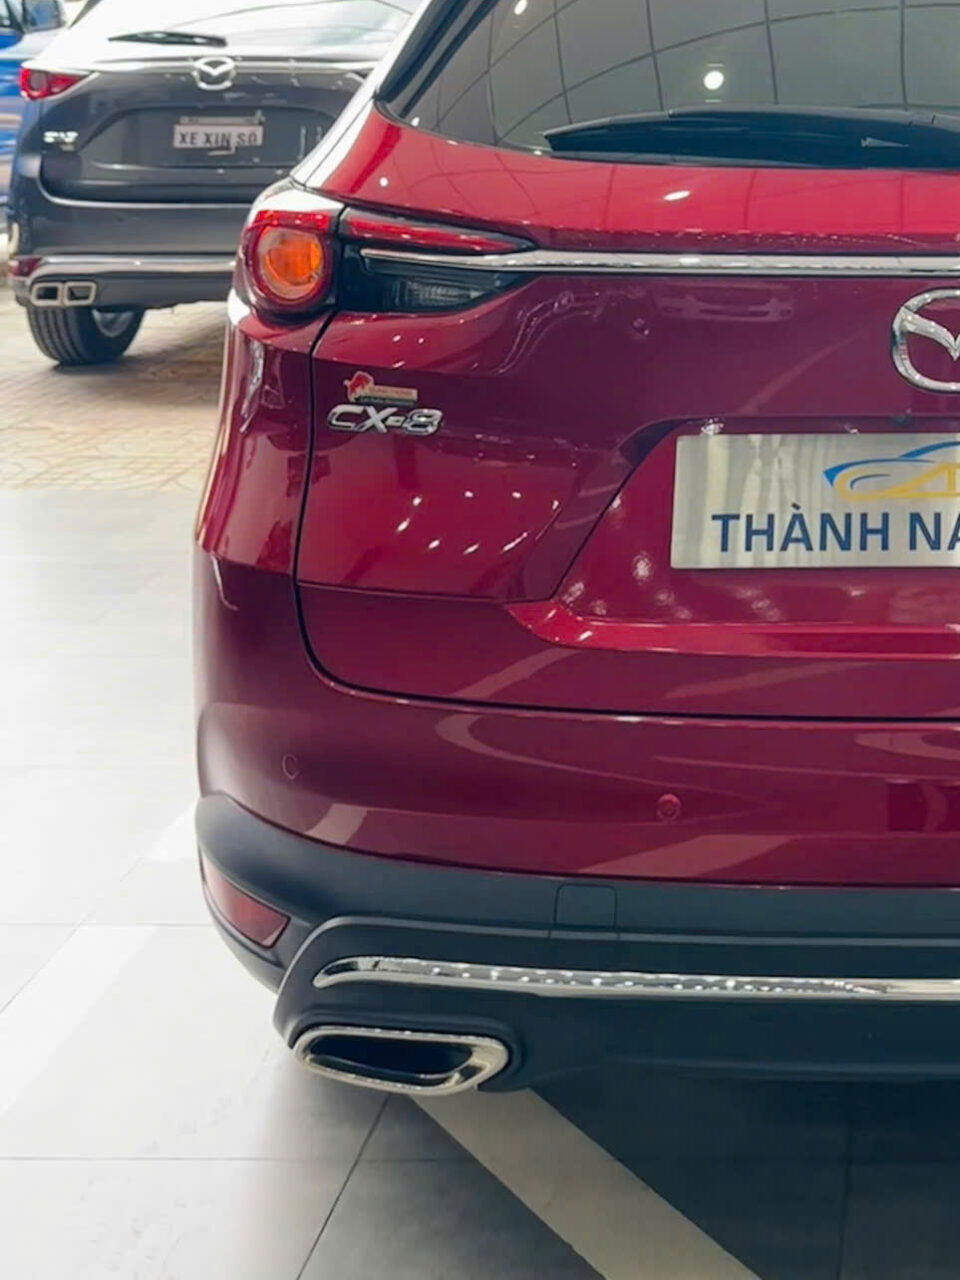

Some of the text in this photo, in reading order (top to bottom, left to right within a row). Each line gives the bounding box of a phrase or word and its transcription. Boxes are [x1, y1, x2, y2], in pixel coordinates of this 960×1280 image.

[179, 131, 199, 145] XE
[204, 131, 233, 148] XIN
[327, 404, 443, 436] CX-8
[711, 501, 890, 553] THÀNH
